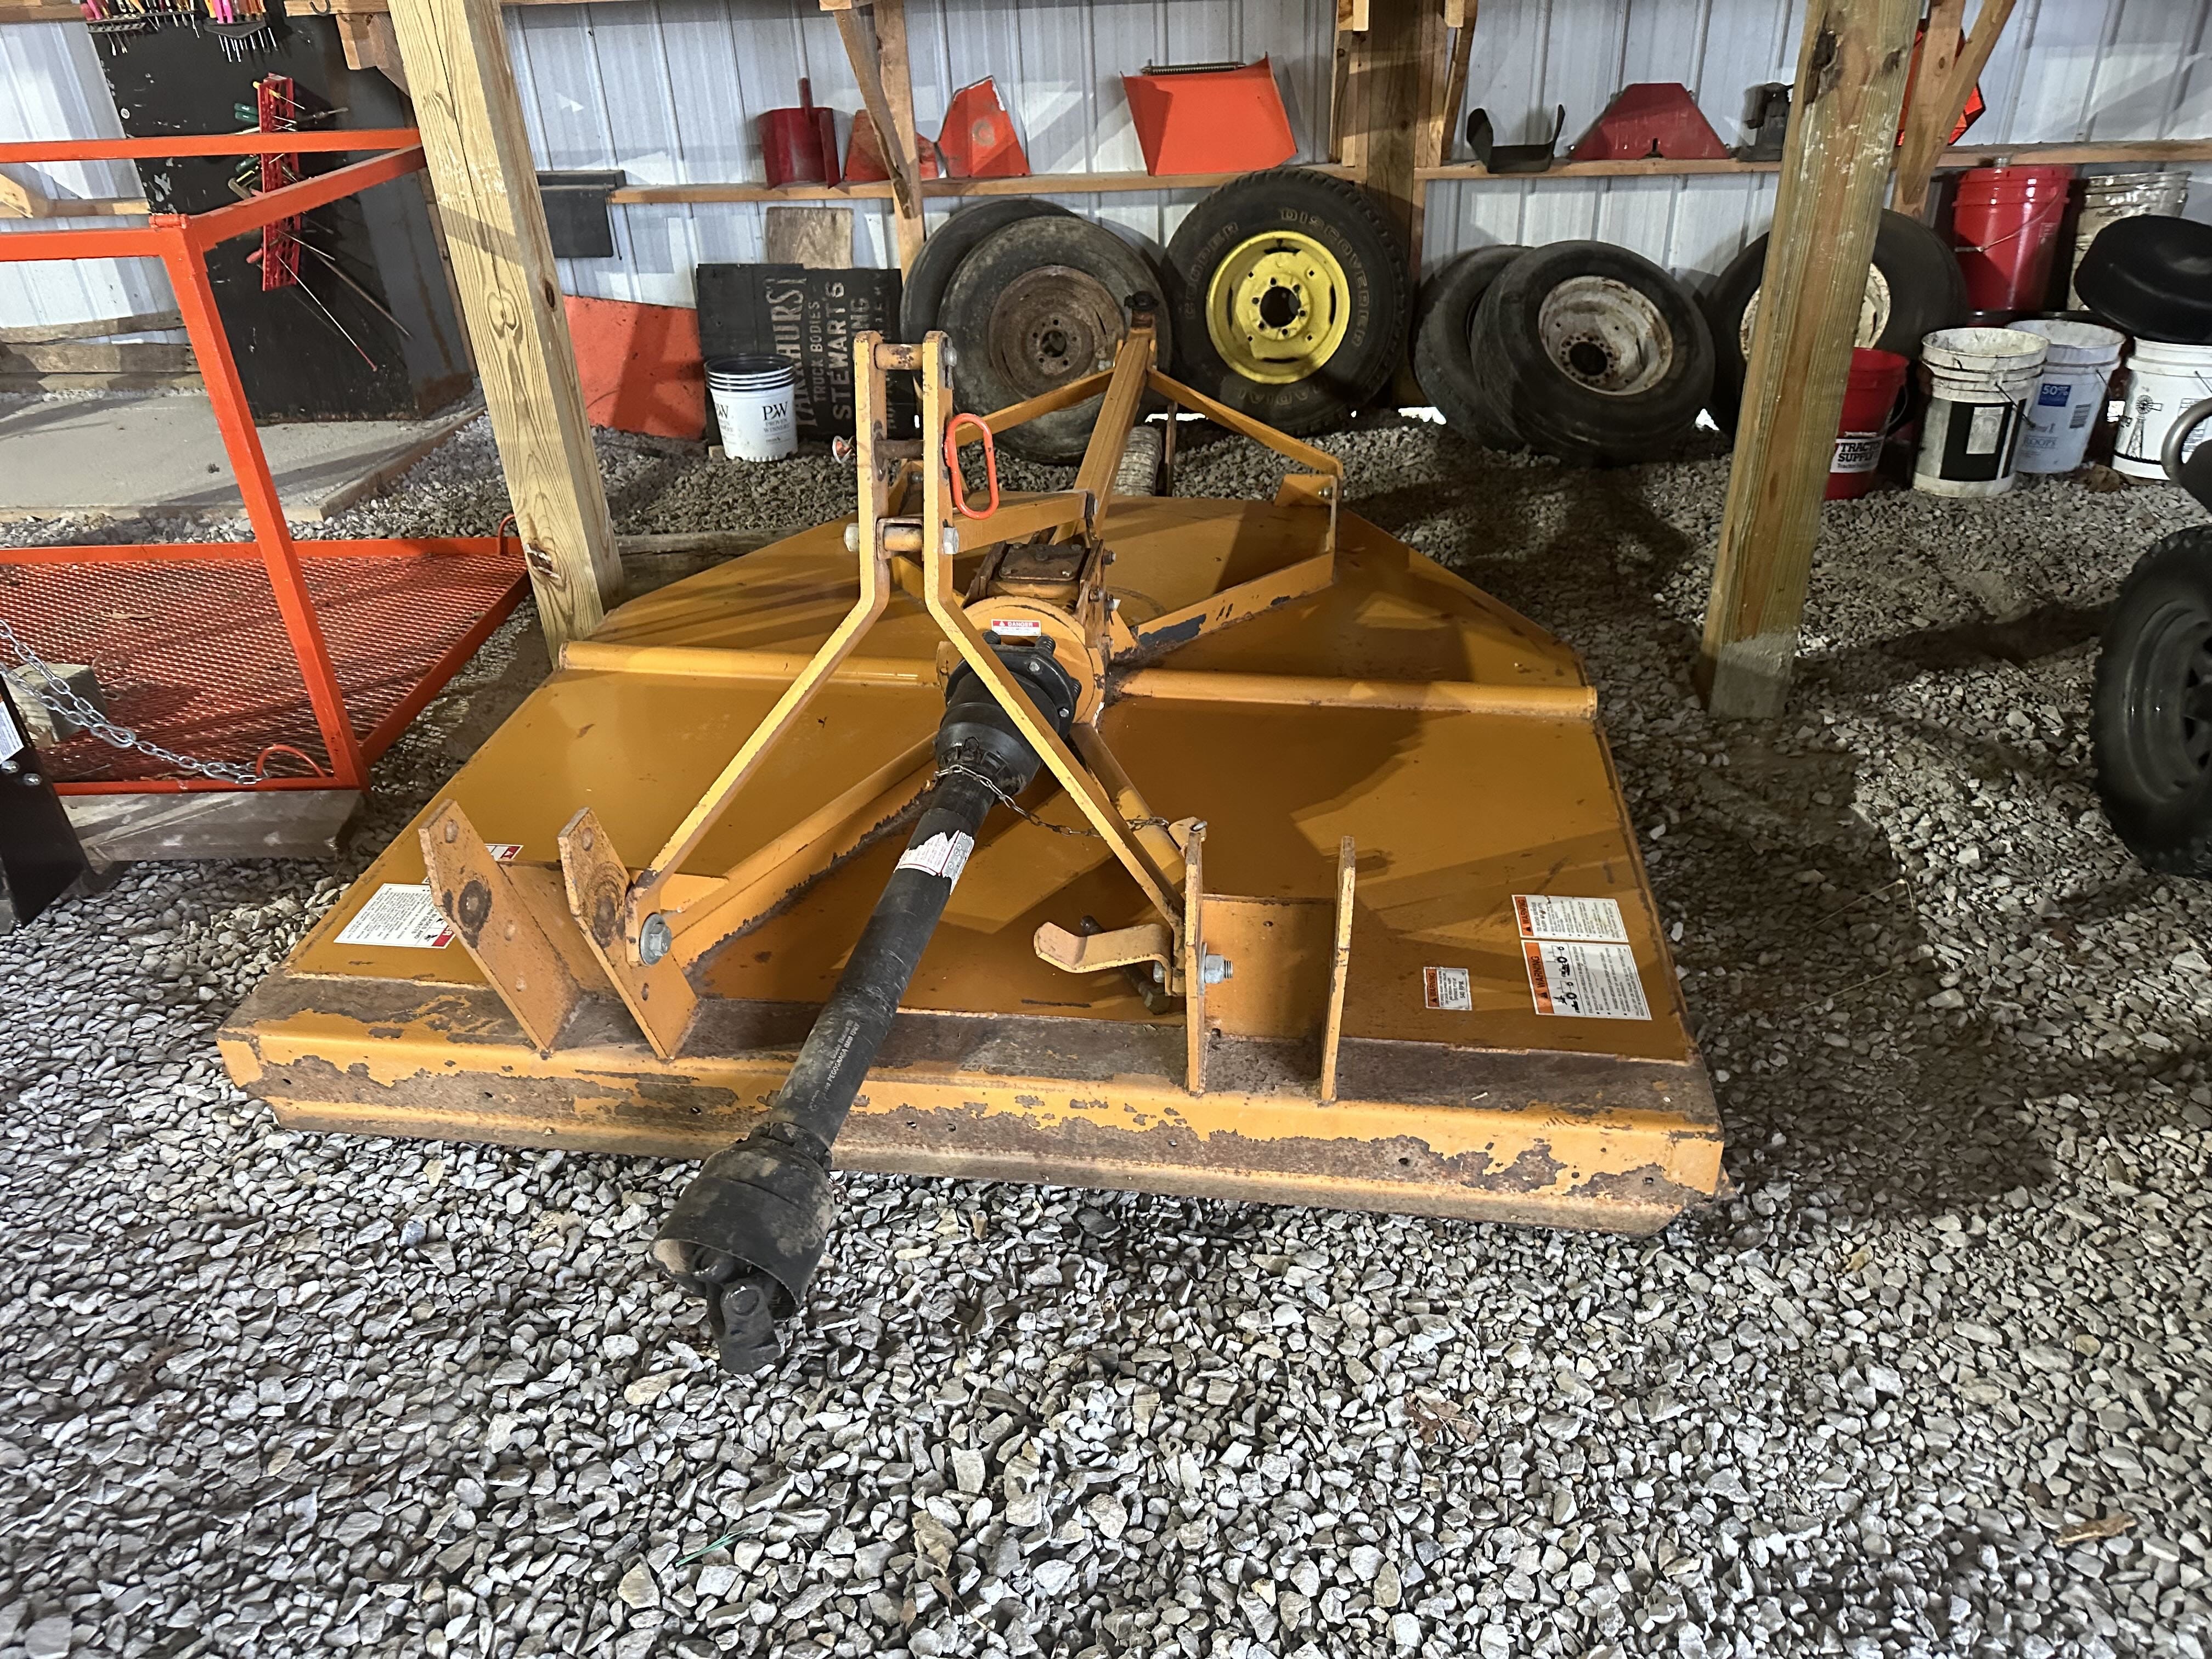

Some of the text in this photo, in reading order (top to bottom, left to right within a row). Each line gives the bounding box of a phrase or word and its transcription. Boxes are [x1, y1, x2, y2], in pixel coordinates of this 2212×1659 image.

[1279, 207, 1370, 347] DISCOVERER
[808, 301, 826, 402] TRUCK BODIES
[761, 400, 788, 421] PW
[1518, 899, 1530, 924] WARNING
[1531, 956, 1545, 988] WARNING
